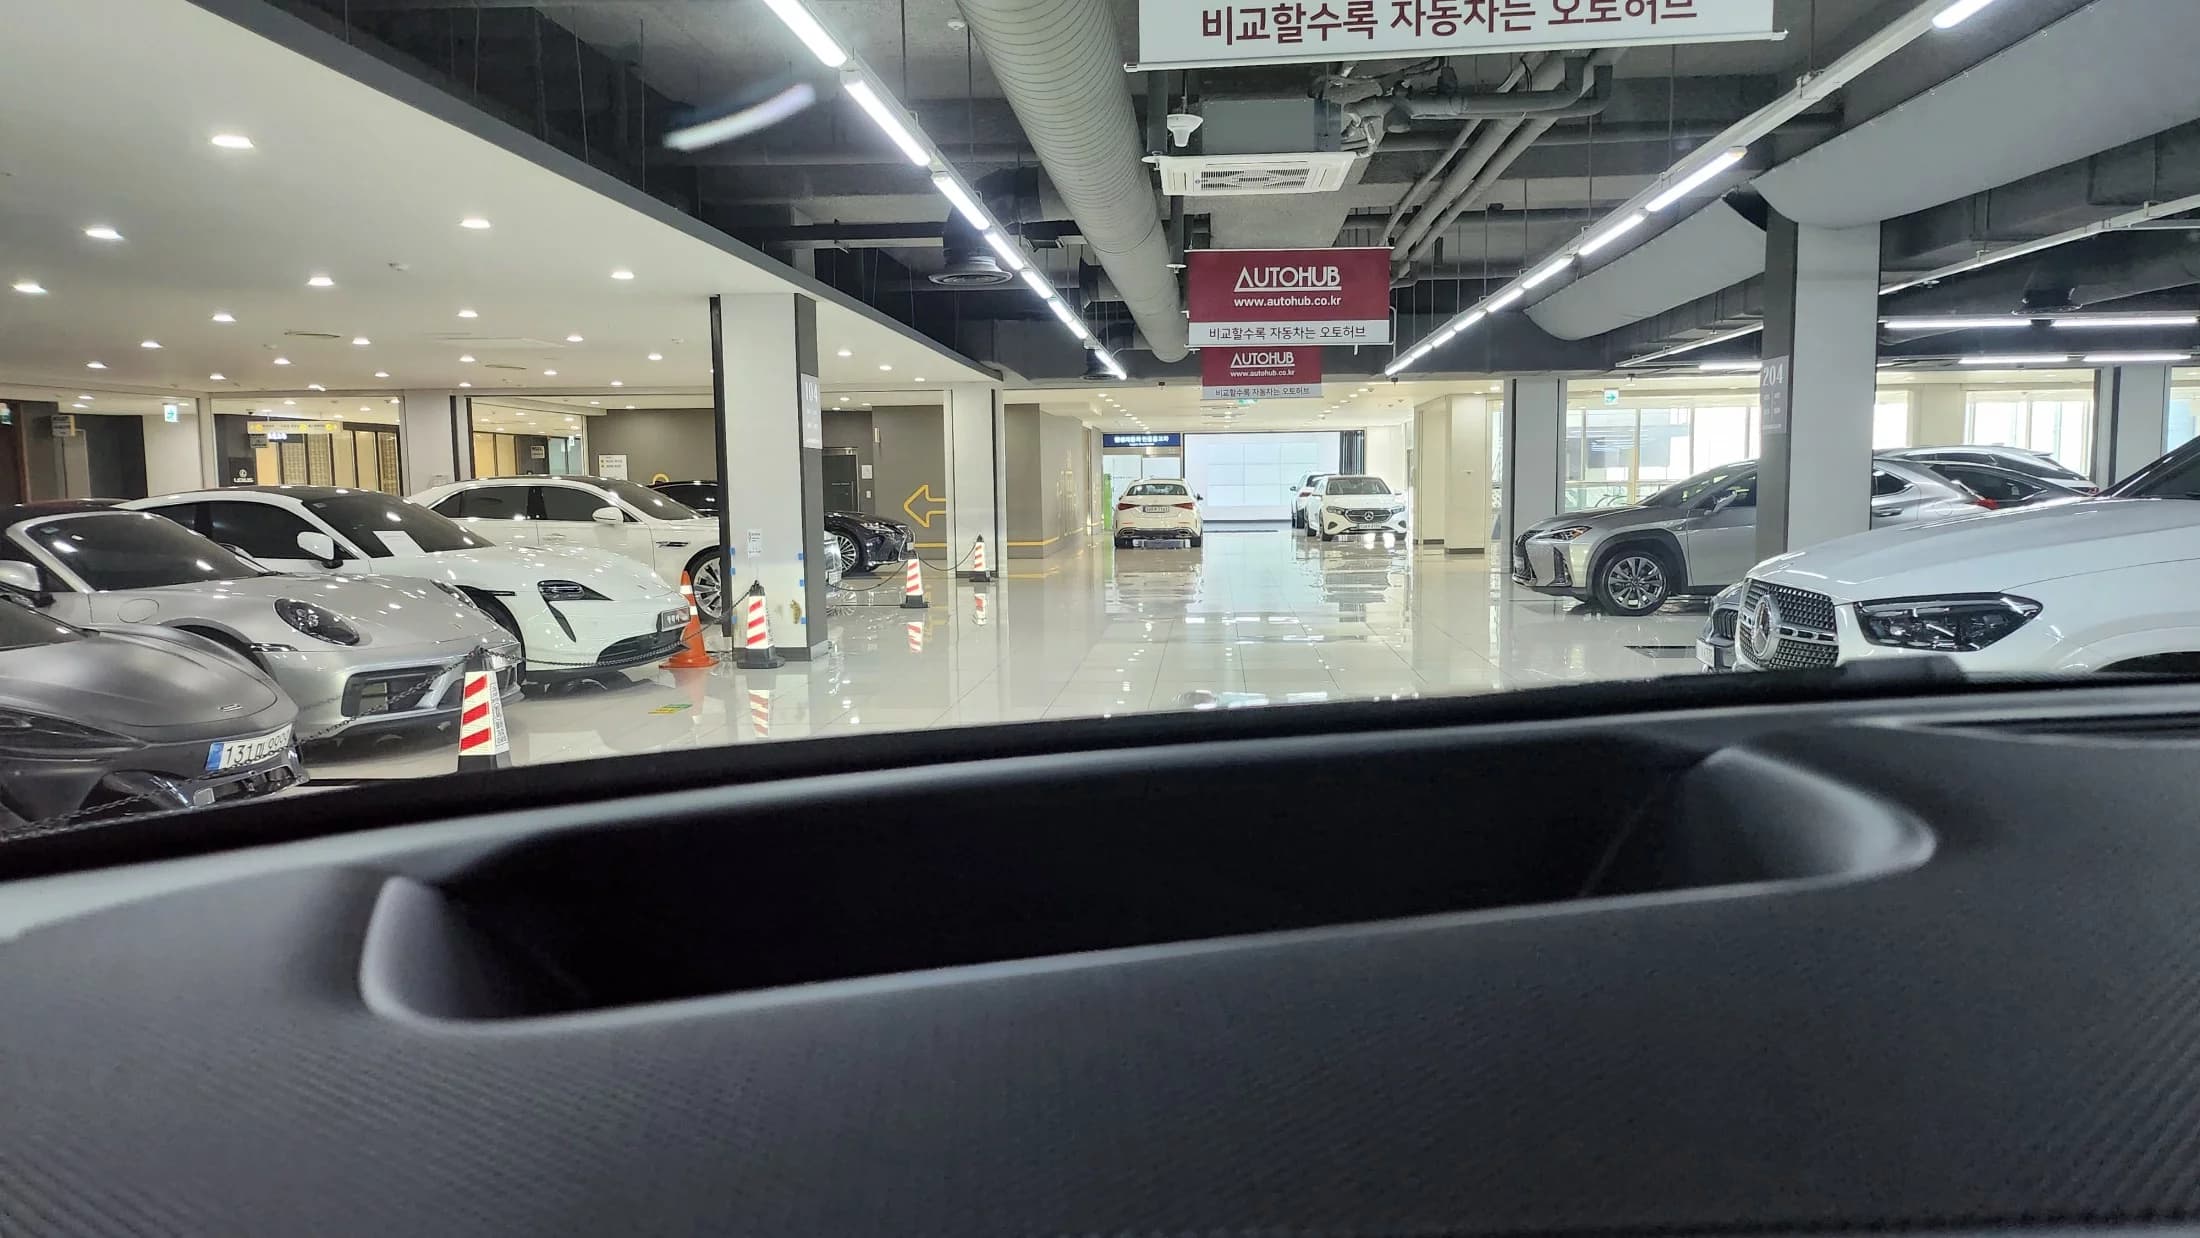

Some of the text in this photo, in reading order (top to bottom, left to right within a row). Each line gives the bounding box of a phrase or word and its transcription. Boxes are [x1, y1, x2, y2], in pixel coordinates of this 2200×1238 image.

[1202, 0, 1379, 46] 비교할수록
[1233, 265, 1342, 293] AUTOHUB
[1233, 296, 1342, 308] www.autohub.co.kr
[1209, 325, 1367, 341] 비교할수록 자동차는 오토허브
[1230, 351, 1296, 369] AUTOHUB
[1230, 369, 1296, 377] www.autohub.co.kr
[1762, 363, 1785, 386] 204
[804, 381, 818, 403] 104
